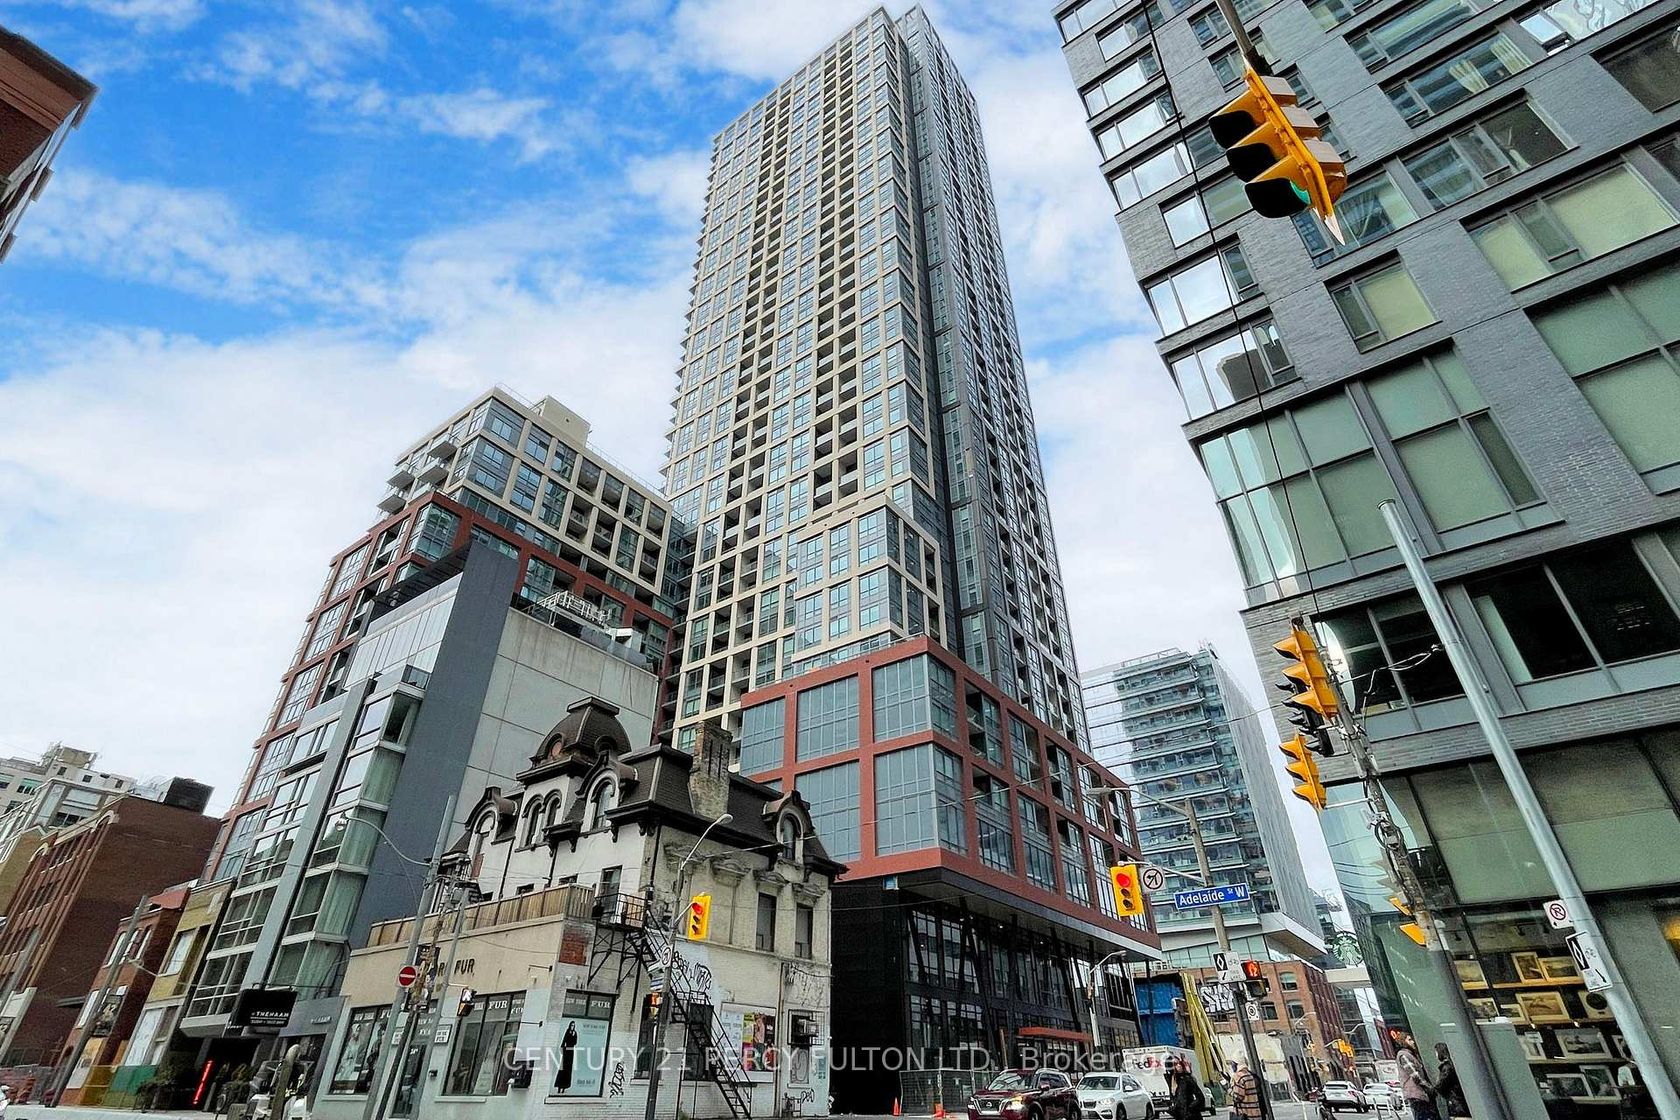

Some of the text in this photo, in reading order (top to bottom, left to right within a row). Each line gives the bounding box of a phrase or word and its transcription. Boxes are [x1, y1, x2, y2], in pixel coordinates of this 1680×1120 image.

[1179, 891, 1225, 906] Adelaide
[1234, 886, 1245, 898] W
[488, 1000, 508, 1010] FUR
[591, 1000, 611, 1009] FUR
[1132, 1057, 1162, 1070] FedEx
